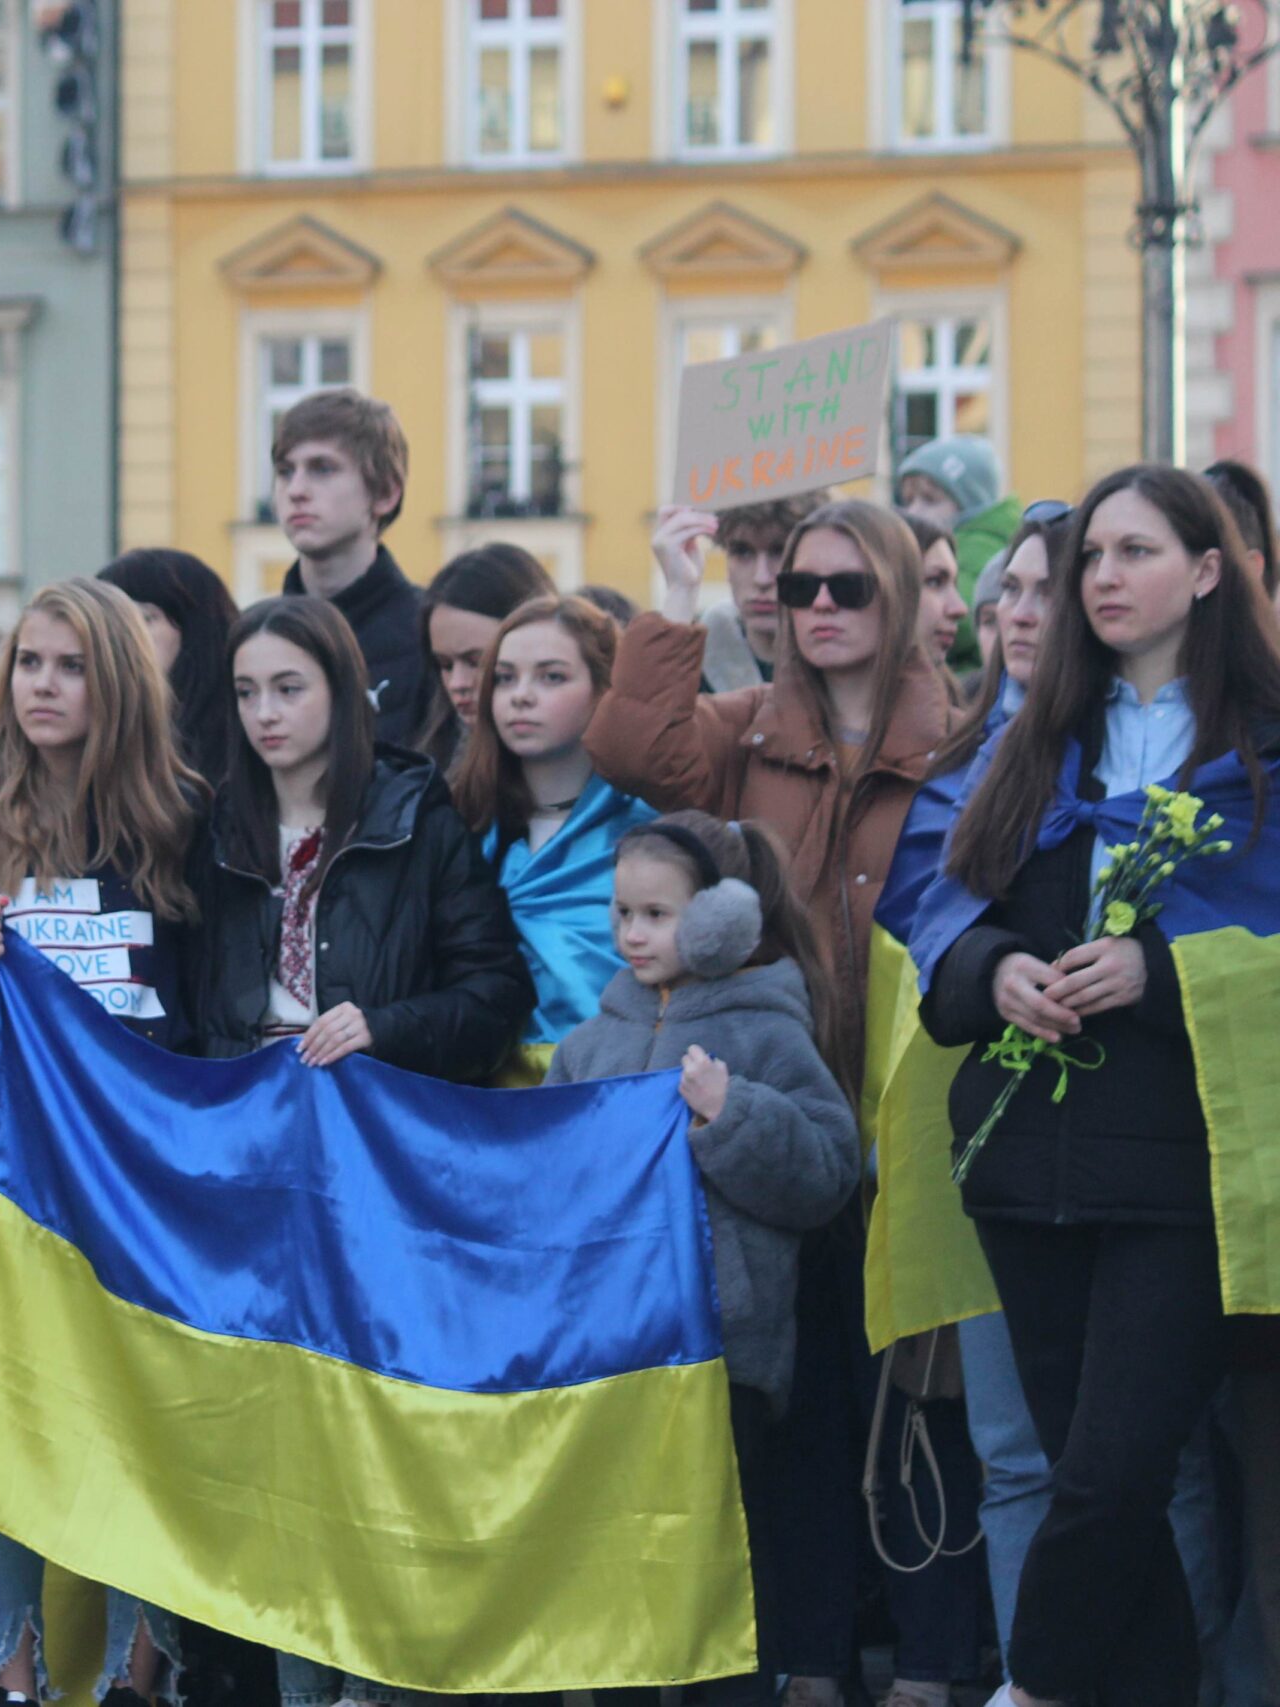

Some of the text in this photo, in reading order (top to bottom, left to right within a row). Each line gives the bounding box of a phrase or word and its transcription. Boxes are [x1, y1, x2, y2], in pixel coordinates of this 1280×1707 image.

[713, 338, 882, 413] STAND
[34, 885, 74, 906] AM
[55, 953, 111, 976] OVE
